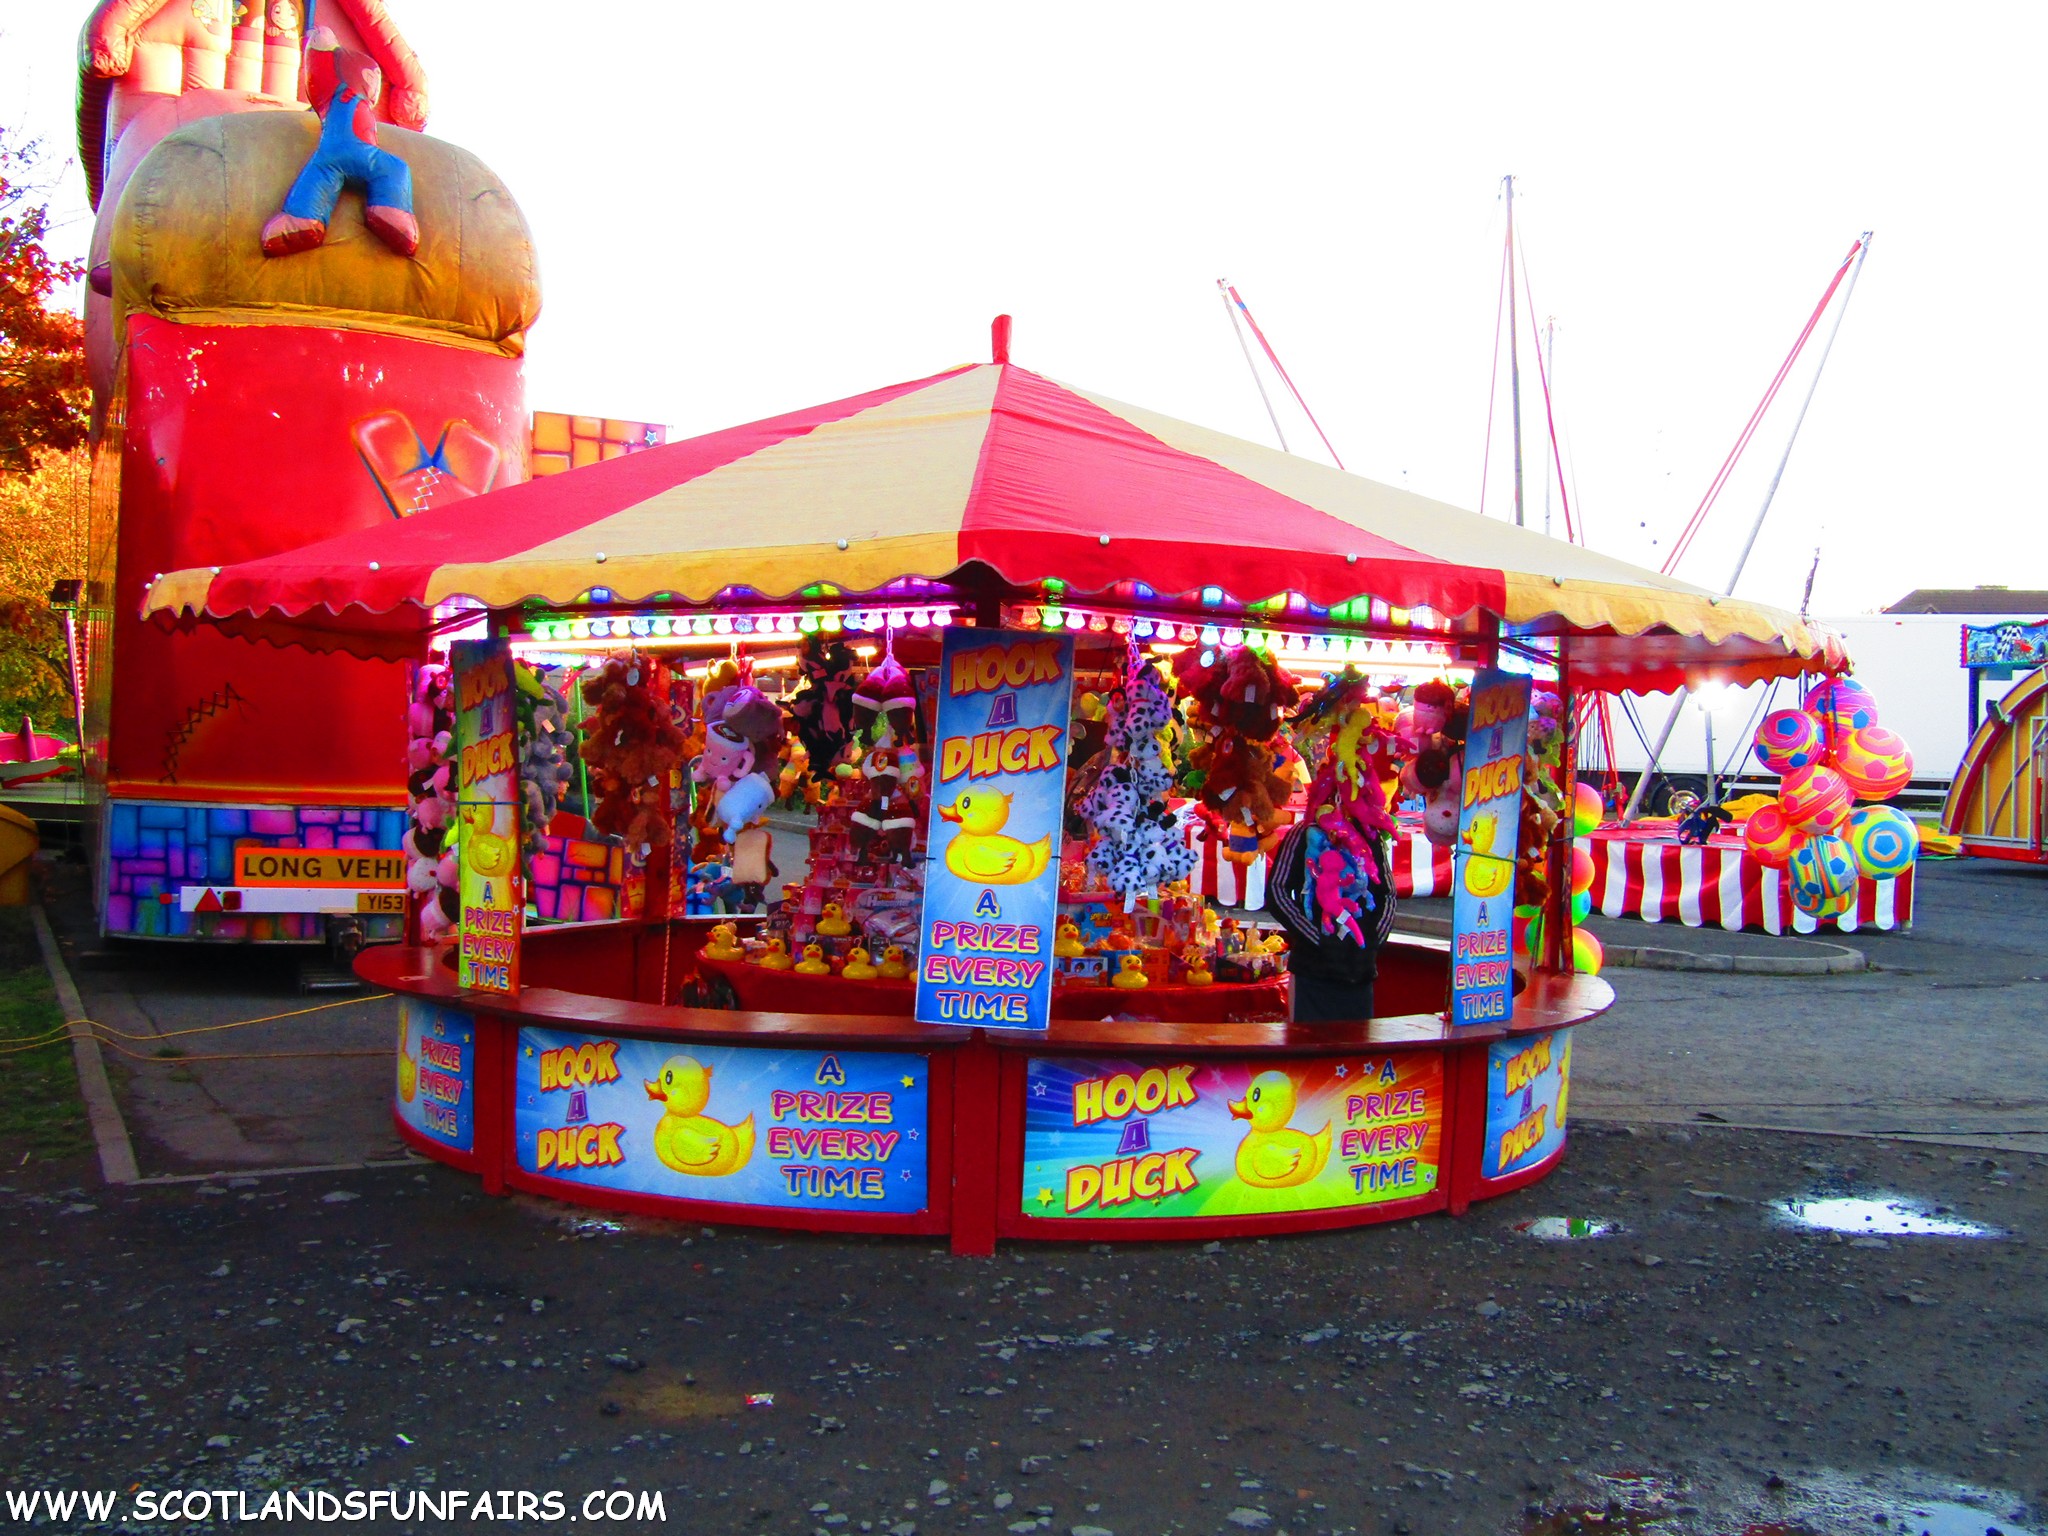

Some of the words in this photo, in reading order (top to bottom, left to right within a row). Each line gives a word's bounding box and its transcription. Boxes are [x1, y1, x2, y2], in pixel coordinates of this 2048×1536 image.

[459, 655, 509, 712] HOOK
[951, 640, 1064, 698] HOOK
[479, 701, 494, 737] A
[986, 692, 1018, 728] A
[1472, 679, 1529, 732] HOOK
[462, 731, 515, 788] DUCK
[940, 724, 1063, 784] DUCK
[1488, 727, 1502, 758] A
[1463, 754, 1523, 810] DUCK
[243, 856, 322, 878] LONG
[338, 858, 407, 879] VEHI
[483, 881, 495, 907] A
[973, 888, 1000, 917] A
[465, 906, 514, 937] PRIZE
[1477, 901, 1489, 927] A
[462, 932, 515, 964] EVERY
[932, 920, 1040, 954] PRIZE
[1457, 929, 1507, 959] PRIZE
[467, 961, 510, 991] TIME
[925, 954, 1044, 988] EVERY
[1455, 961, 1510, 990] EVERY
[434, 1009, 445, 1036] A
[936, 990, 1028, 1022] TIME
[1461, 991, 1504, 1020] TIME
[421, 1035, 461, 1073] PRIZE
[540, 1040, 622, 1092] HOOK
[815, 1055, 845, 1086] A
[1505, 1034, 1552, 1099] HOOK
[420, 1066, 463, 1105] EVERY
[1379, 1058, 1396, 1086] A
[566, 1090, 589, 1122] A
[771, 1089, 893, 1124] PRIZE
[1073, 1064, 1200, 1127] HOOK
[1346, 1088, 1426, 1124] PRIZE
[1520, 1084, 1532, 1118] A
[423, 1100, 458, 1137] TIME
[536, 1122, 626, 1171] DUCK
[767, 1127, 899, 1161] EVERY
[1116, 1118, 1150, 1155] A
[1340, 1122, 1428, 1160] EVERY
[1498, 1103, 1548, 1172] DUCK
[781, 1166, 885, 1199] TIME
[1065, 1147, 1201, 1214] DUCK
[1350, 1159, 1418, 1195] TIME
